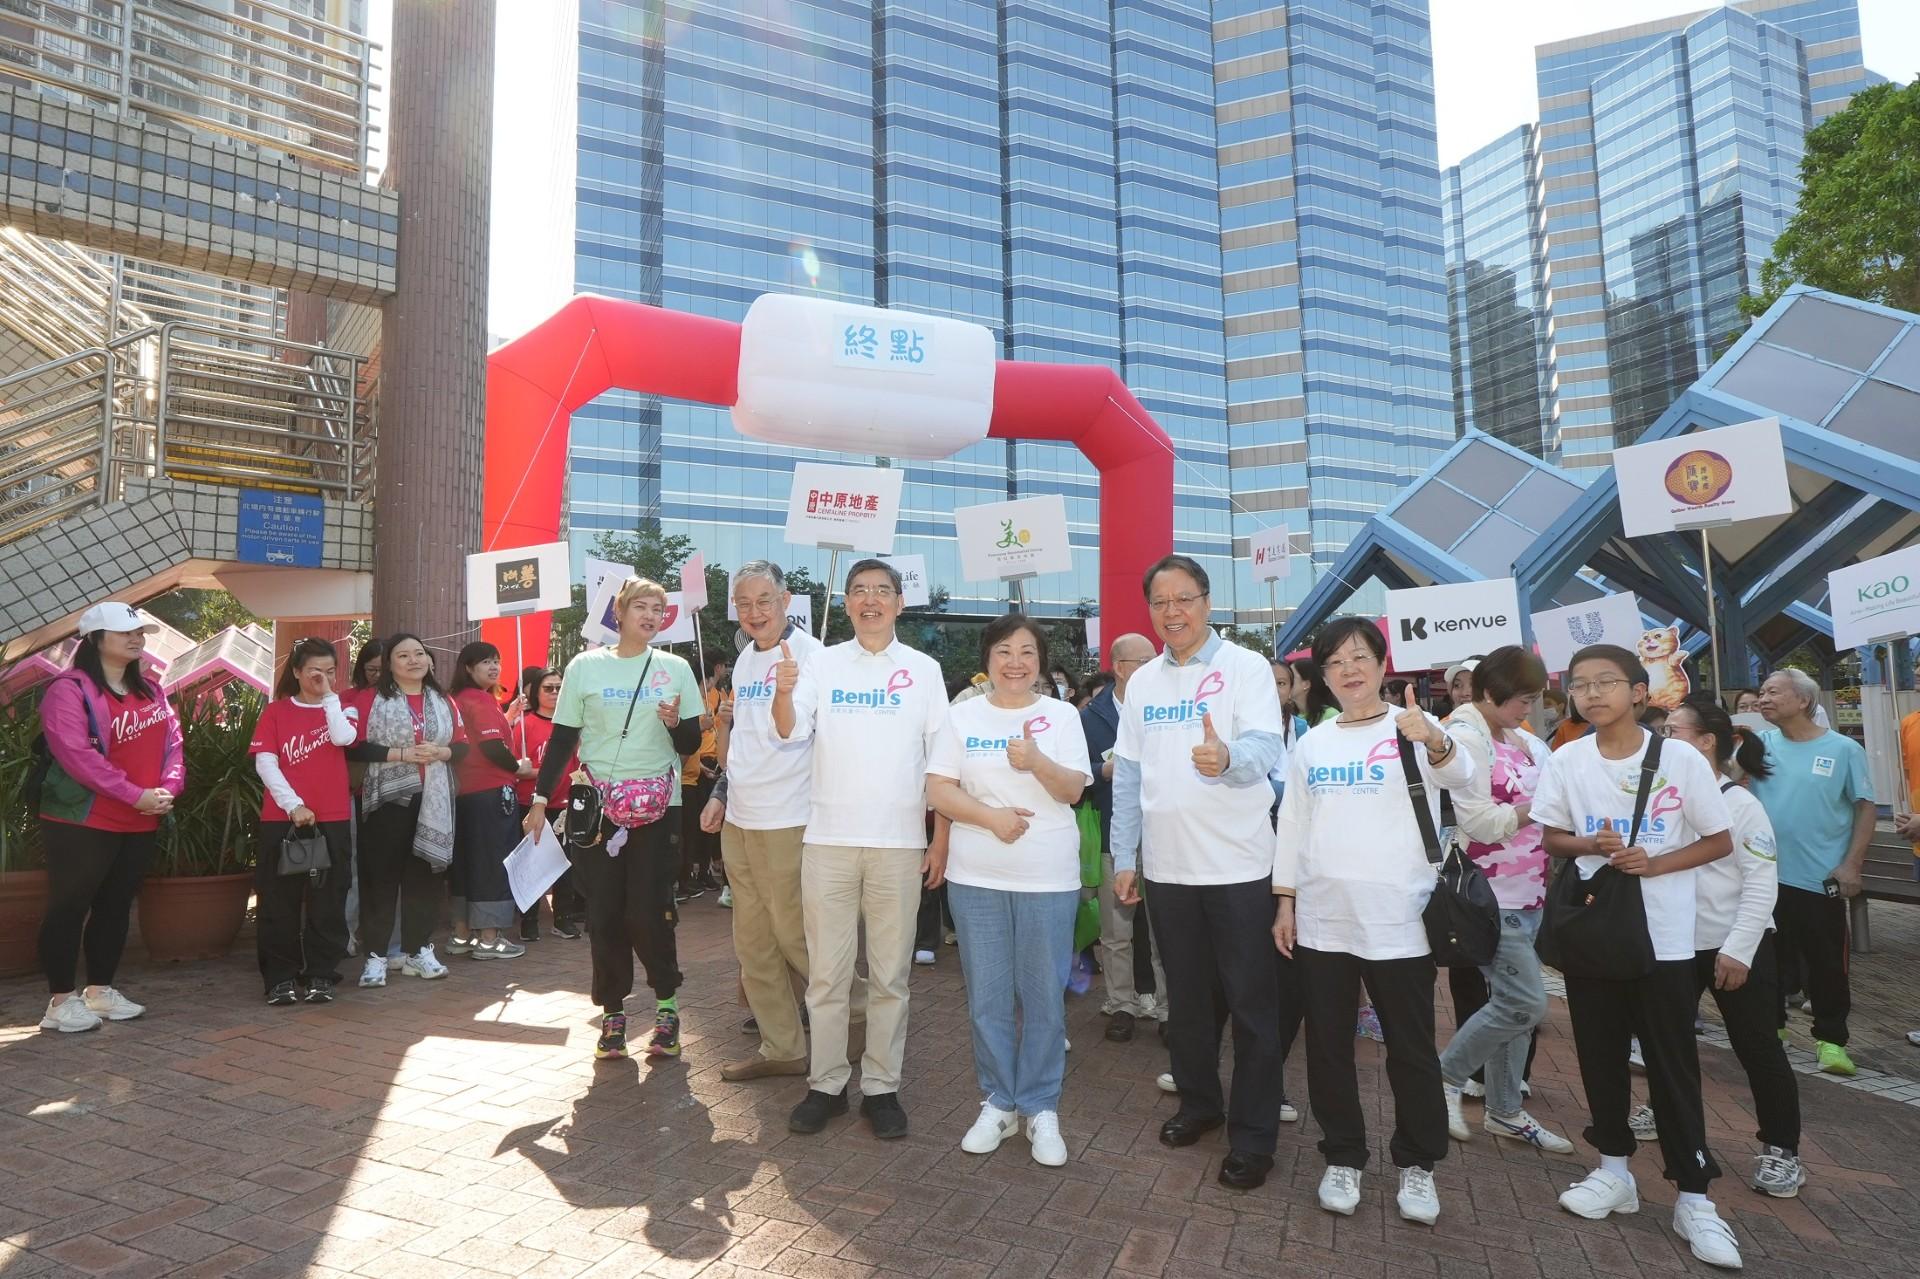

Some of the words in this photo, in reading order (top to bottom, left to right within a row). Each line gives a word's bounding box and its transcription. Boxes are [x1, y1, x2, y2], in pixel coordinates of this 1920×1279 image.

[844, 324, 924, 363] 終點
[273, 495, 293, 504] 注意
[819, 491, 879, 511] 中原地產
[263, 521, 300, 532] Caution
[1352, 787, 1379, 795] CENTRE
